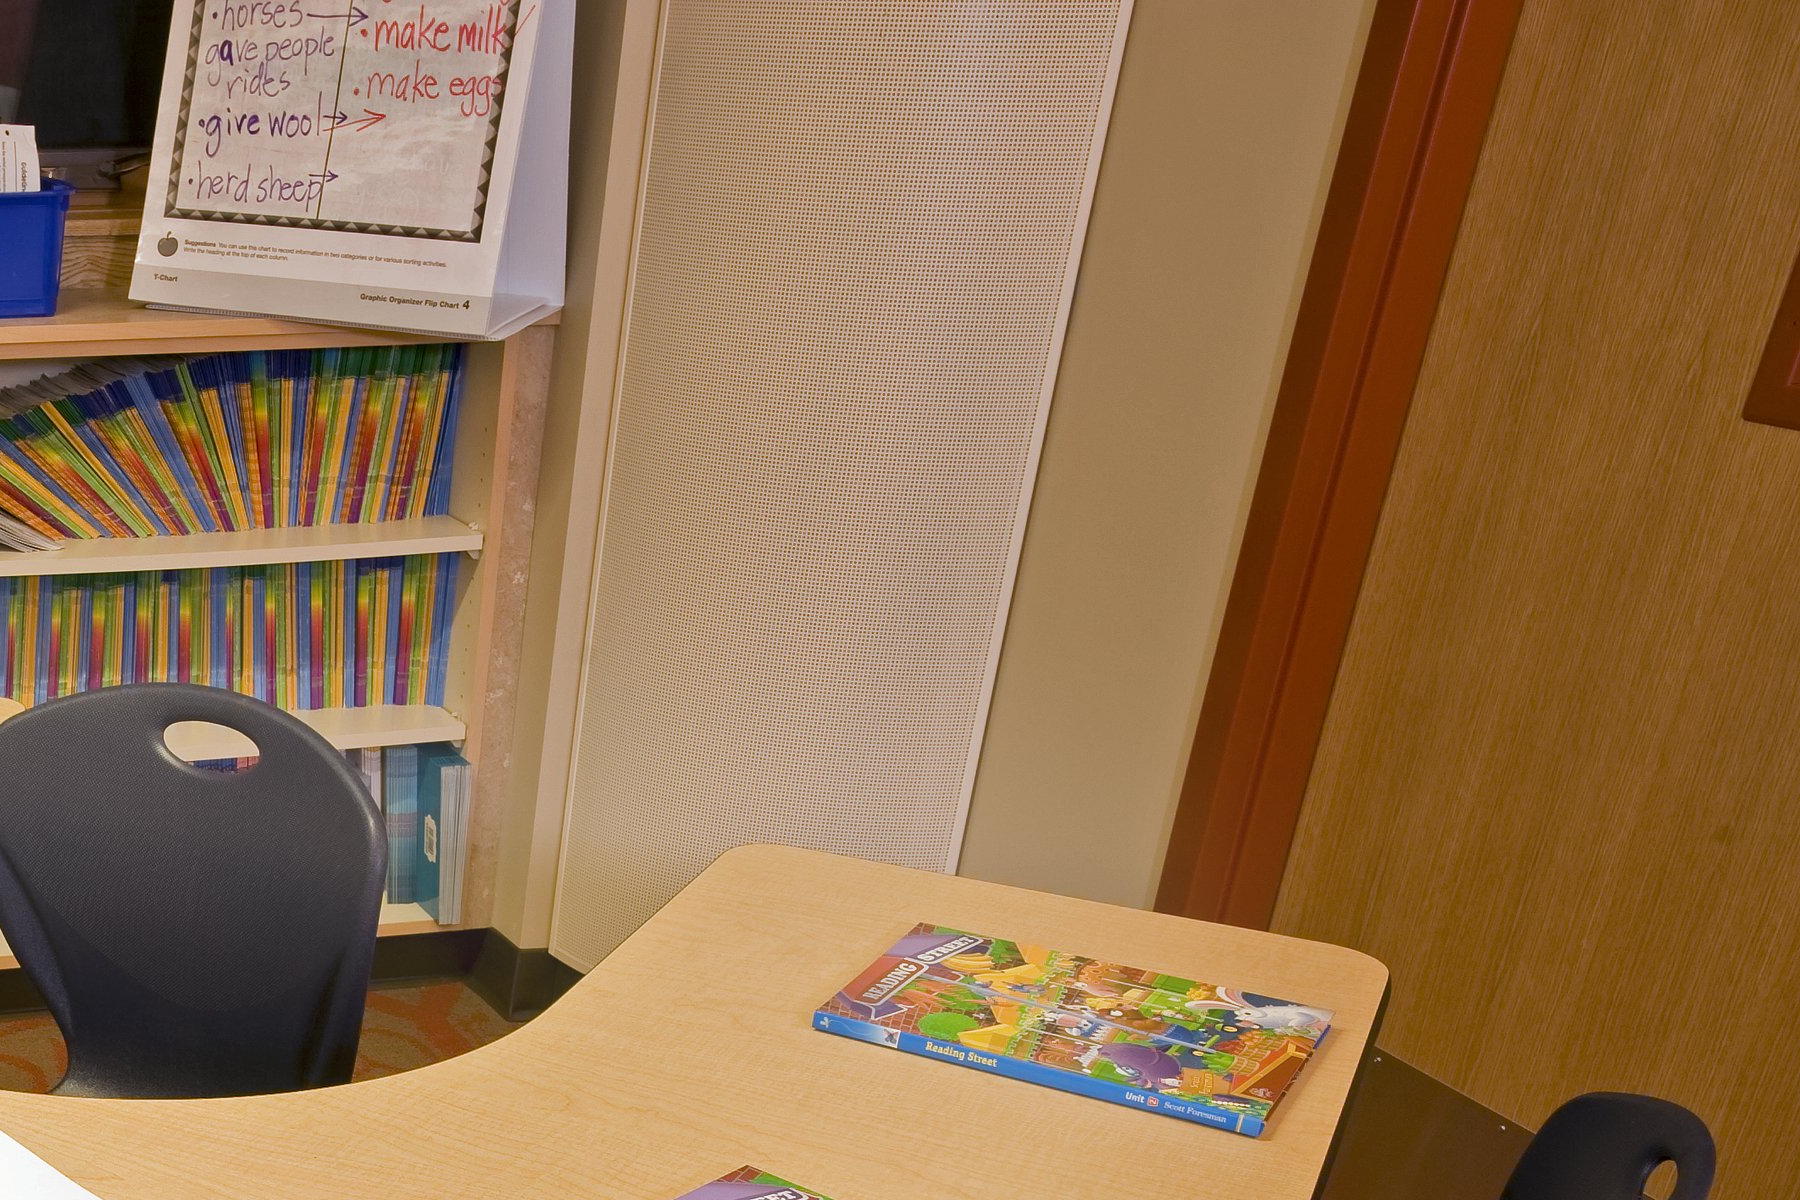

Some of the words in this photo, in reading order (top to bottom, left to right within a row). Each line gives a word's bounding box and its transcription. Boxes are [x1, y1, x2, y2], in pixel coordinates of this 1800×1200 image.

[221, 0, 303, 31] horses
[375, 16, 450, 51] make
[458, 4, 508, 54] milk
[205, 40, 258, 87] gave
[265, 26, 335, 76] people
[227, 62, 291, 99] rides
[368, 59, 440, 103] make
[449, 75, 502, 117] eggs
[205, 107, 260, 158] give
[269, 91, 321, 138] wool
[197, 160, 251, 204] herd
[256, 164, 324, 212] sheep
[184, 239, 217, 248] Suggestions
[219, 241, 227, 249] You
[295, 249, 324, 257] information
[341, 253, 368, 261] categories
[403, 258, 422, 266] sorting
[206, 248, 226, 256] heading
[154, 273, 178, 282] T-Chart
[360, 293, 387, 304] Graphic
[389, 295, 423, 307] Organizer
[425, 298, 438, 309] Flip
[439, 299, 460, 310] Chart
[462, 300, 471, 310] 4
[862, 962, 917, 1000] READING
[917, 936, 975, 962] STREET
[925, 1041, 965, 1061] Reading
[967, 1051, 998, 1068] Street
[1125, 1091, 1145, 1104] Unit
[1163, 1100, 1185, 1113] Scott
[1186, 1107, 1227, 1123] Foresman
